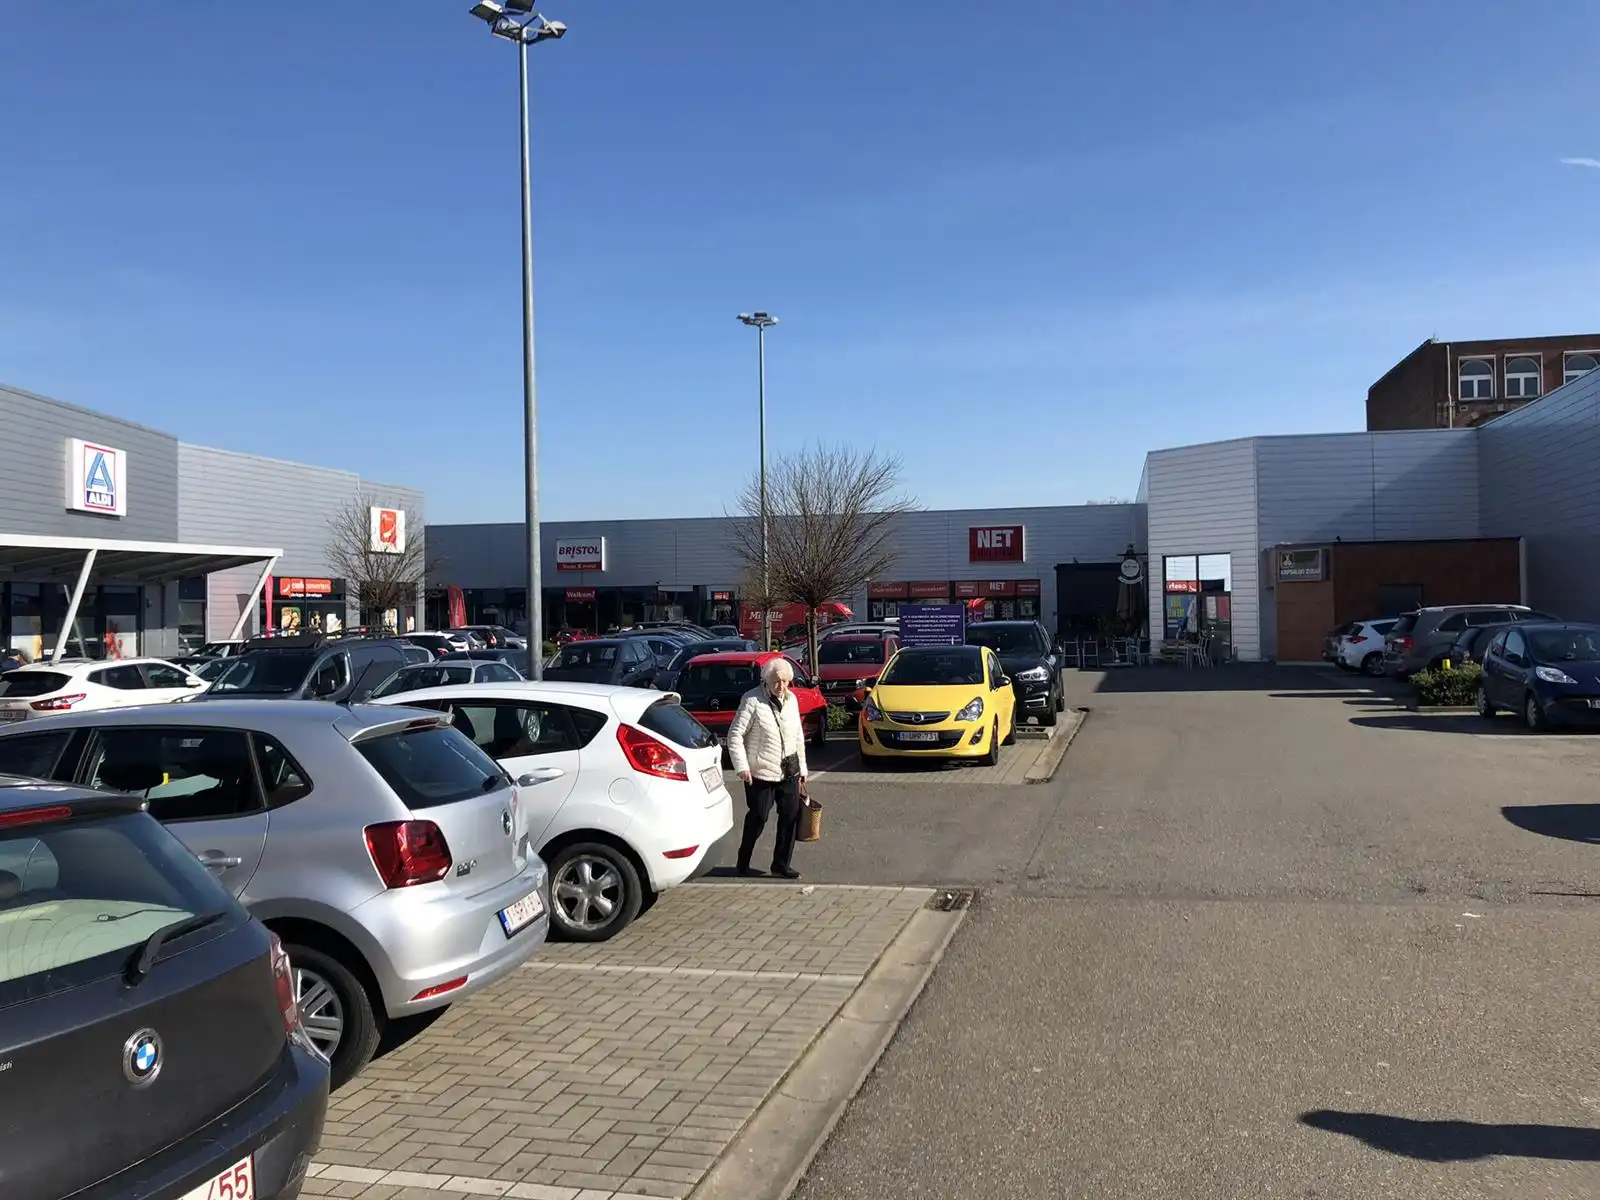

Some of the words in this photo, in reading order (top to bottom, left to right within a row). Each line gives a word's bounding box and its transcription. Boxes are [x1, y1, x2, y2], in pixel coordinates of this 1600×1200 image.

[88, 492, 113, 507] ALDI
[977, 529, 1014, 548] NET
[558, 545, 600, 558] BRISTOL
[989, 581, 1006, 591] NET
